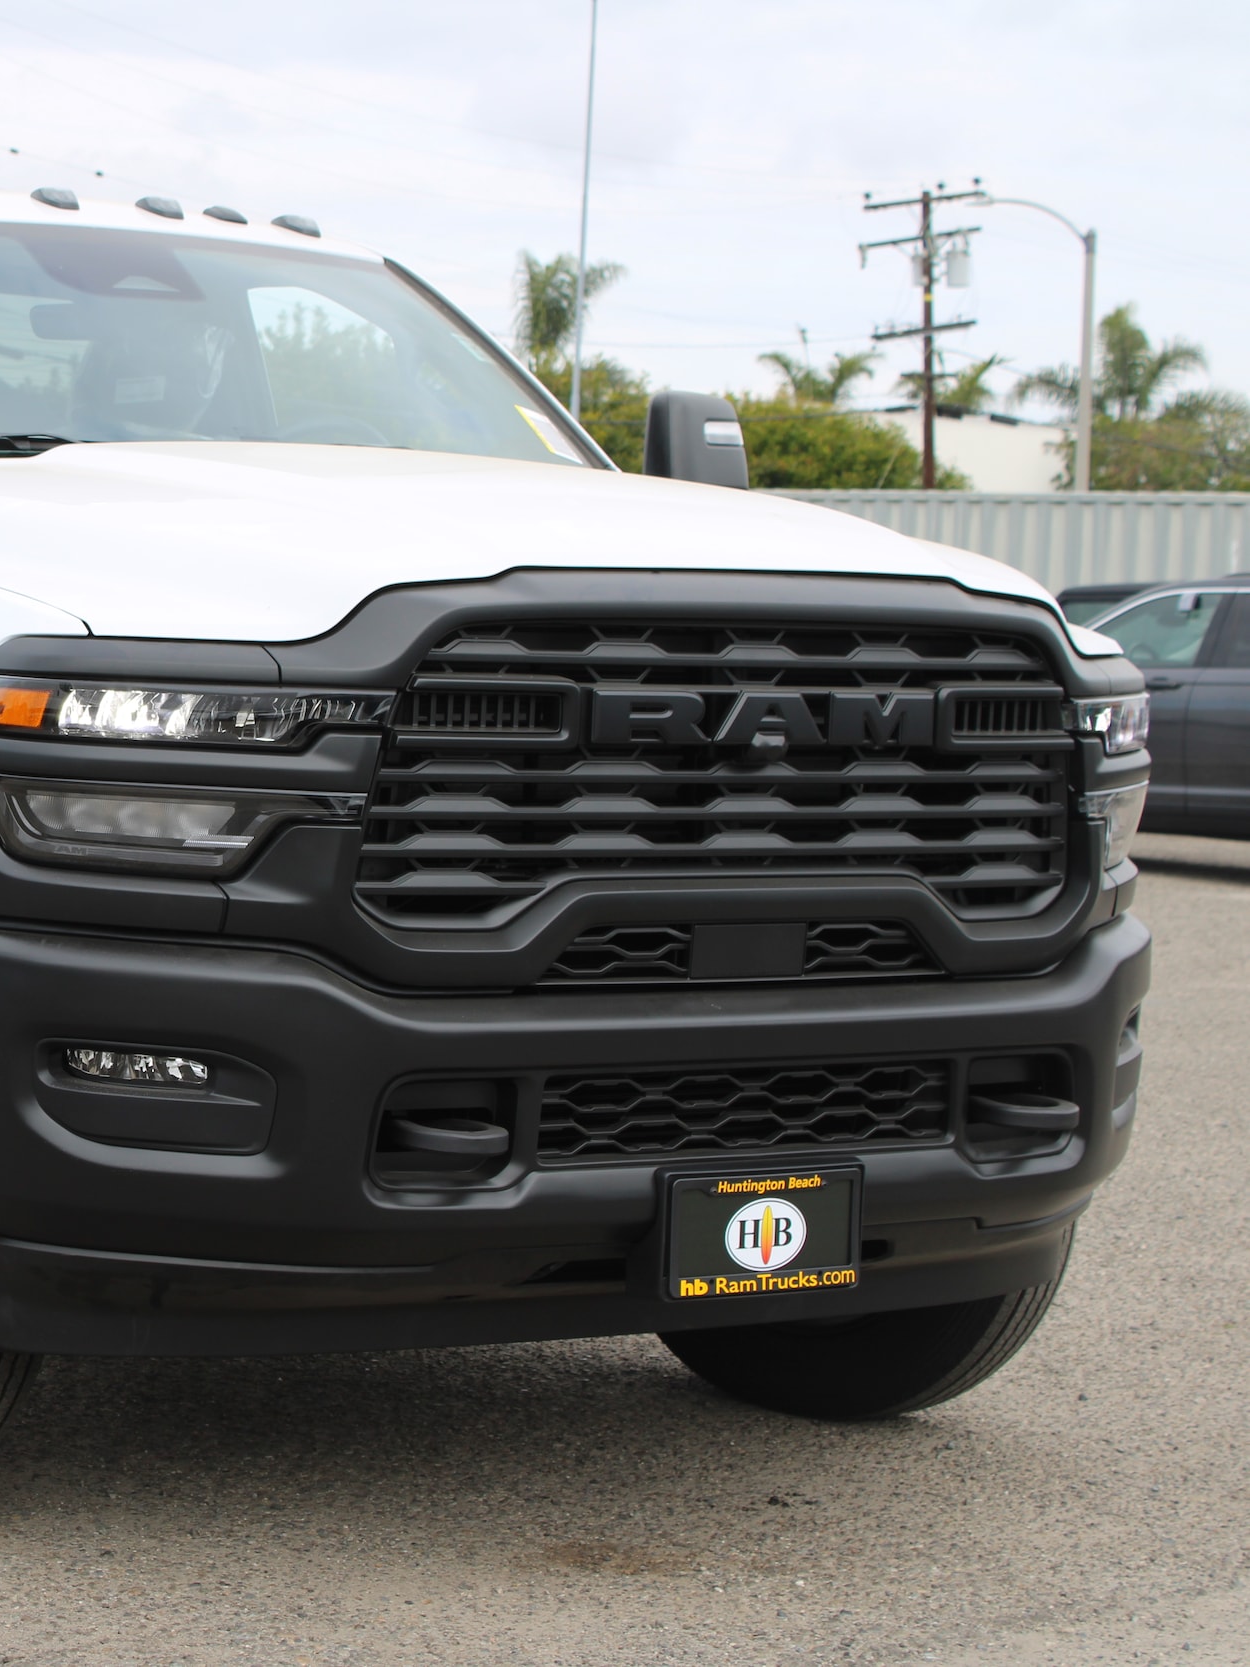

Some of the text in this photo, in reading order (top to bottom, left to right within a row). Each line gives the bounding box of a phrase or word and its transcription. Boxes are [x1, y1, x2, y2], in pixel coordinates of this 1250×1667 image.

[592, 689, 935, 747] RAM
[717, 1174, 822, 1195] Huntington Beach
[680, 1279, 709, 1297] hb
